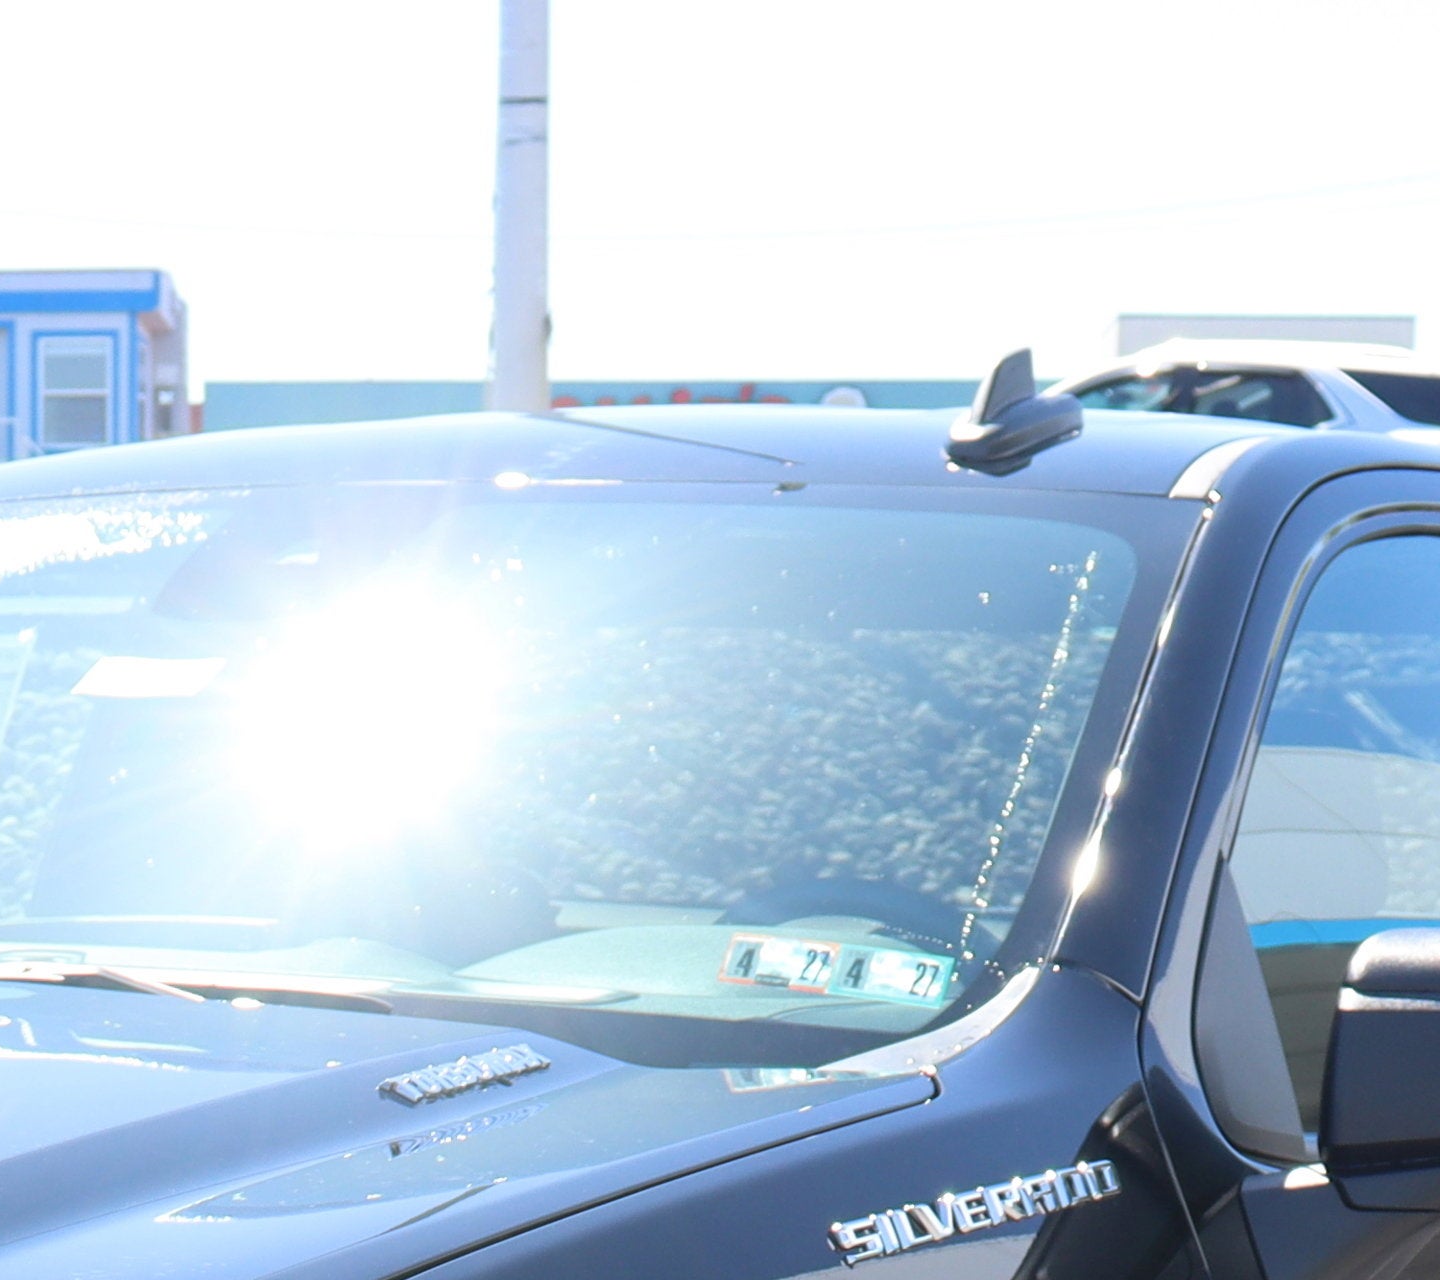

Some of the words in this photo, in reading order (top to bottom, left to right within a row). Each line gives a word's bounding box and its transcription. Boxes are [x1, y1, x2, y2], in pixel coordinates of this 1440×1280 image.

[735, 949, 756, 978] 4
[799, 948, 831, 984] 27
[845, 956, 866, 989] 4
[908, 962, 941, 998] 27
[826, 1159, 1121, 1268] SILVERADO
